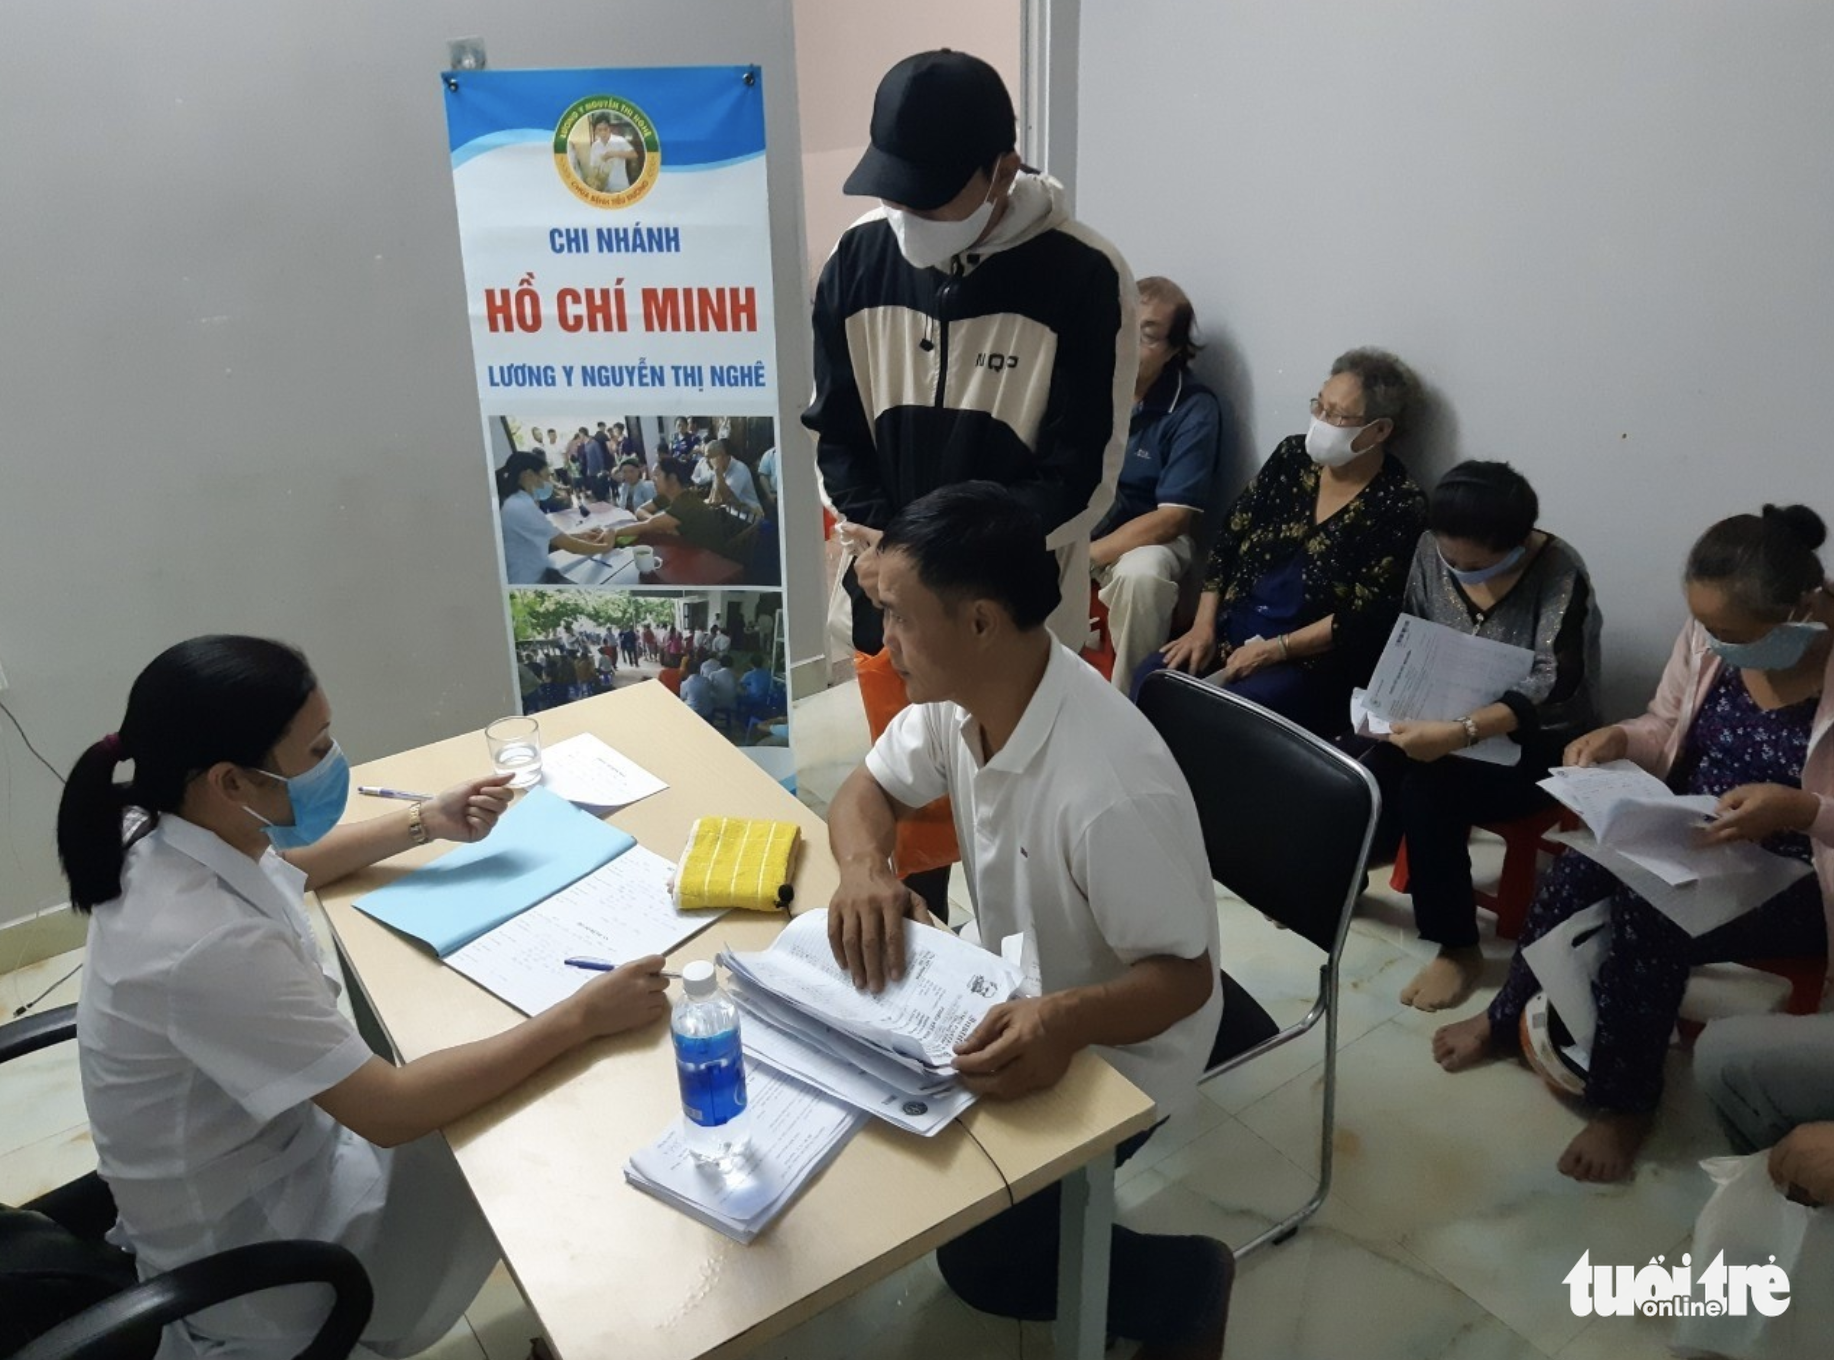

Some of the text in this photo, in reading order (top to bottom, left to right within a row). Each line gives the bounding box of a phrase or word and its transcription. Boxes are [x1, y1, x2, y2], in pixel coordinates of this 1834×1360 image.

[550, 221, 681, 254] CHI NHÁNH
[484, 272, 758, 334] HỒ CHÍ MINH
[488, 357, 767, 392] LƯƠNG Y NGUYỄN THỊ NGHÊ
